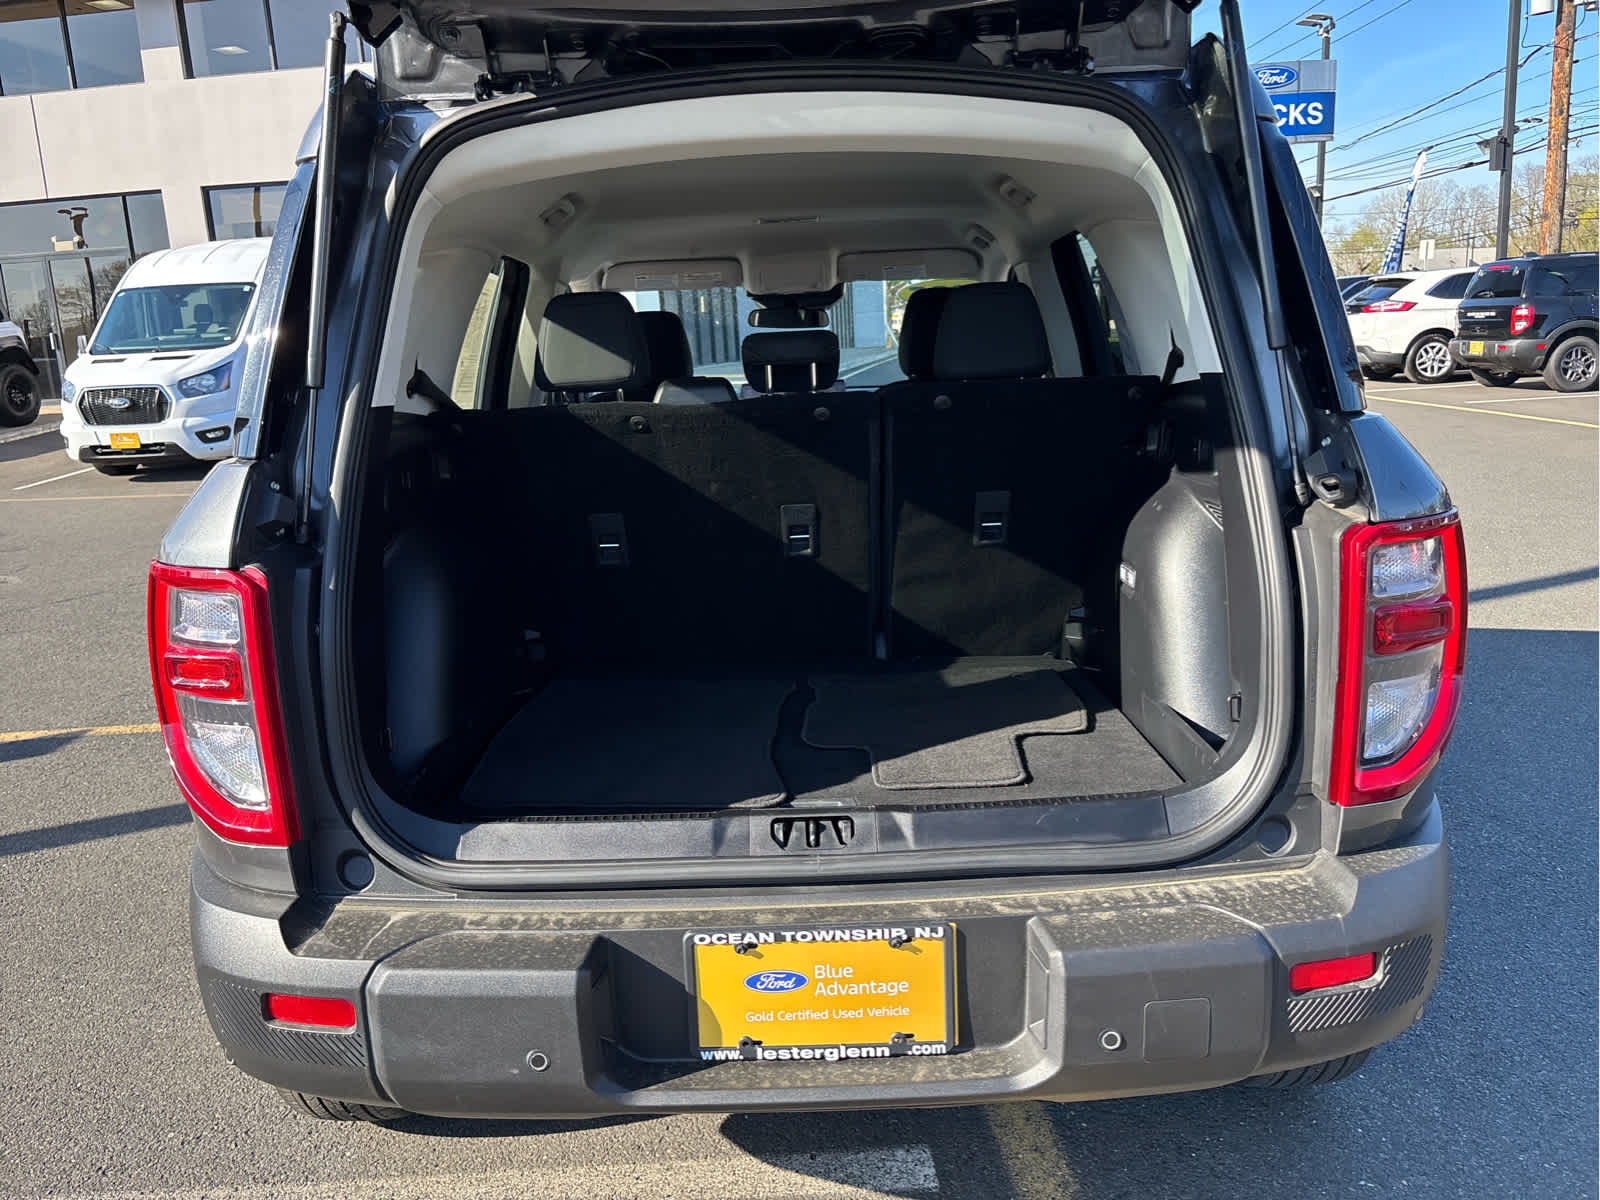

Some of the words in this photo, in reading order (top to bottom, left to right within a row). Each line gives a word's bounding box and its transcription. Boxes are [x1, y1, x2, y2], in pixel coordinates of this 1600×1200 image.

[1258, 69, 1288, 84] Ford
[693, 932, 775, 945] OCEAN
[914, 927, 944, 938] NJ
[814, 964, 853, 979] Blue
[756, 973, 797, 989] Ford
[814, 980, 909, 996] Advantage
[745, 1011, 774, 1023] Gold
[777, 1008, 829, 1021] Certified
[832, 1007, 863, 1019] Used
[867, 1005, 910, 1017] Vehicle
